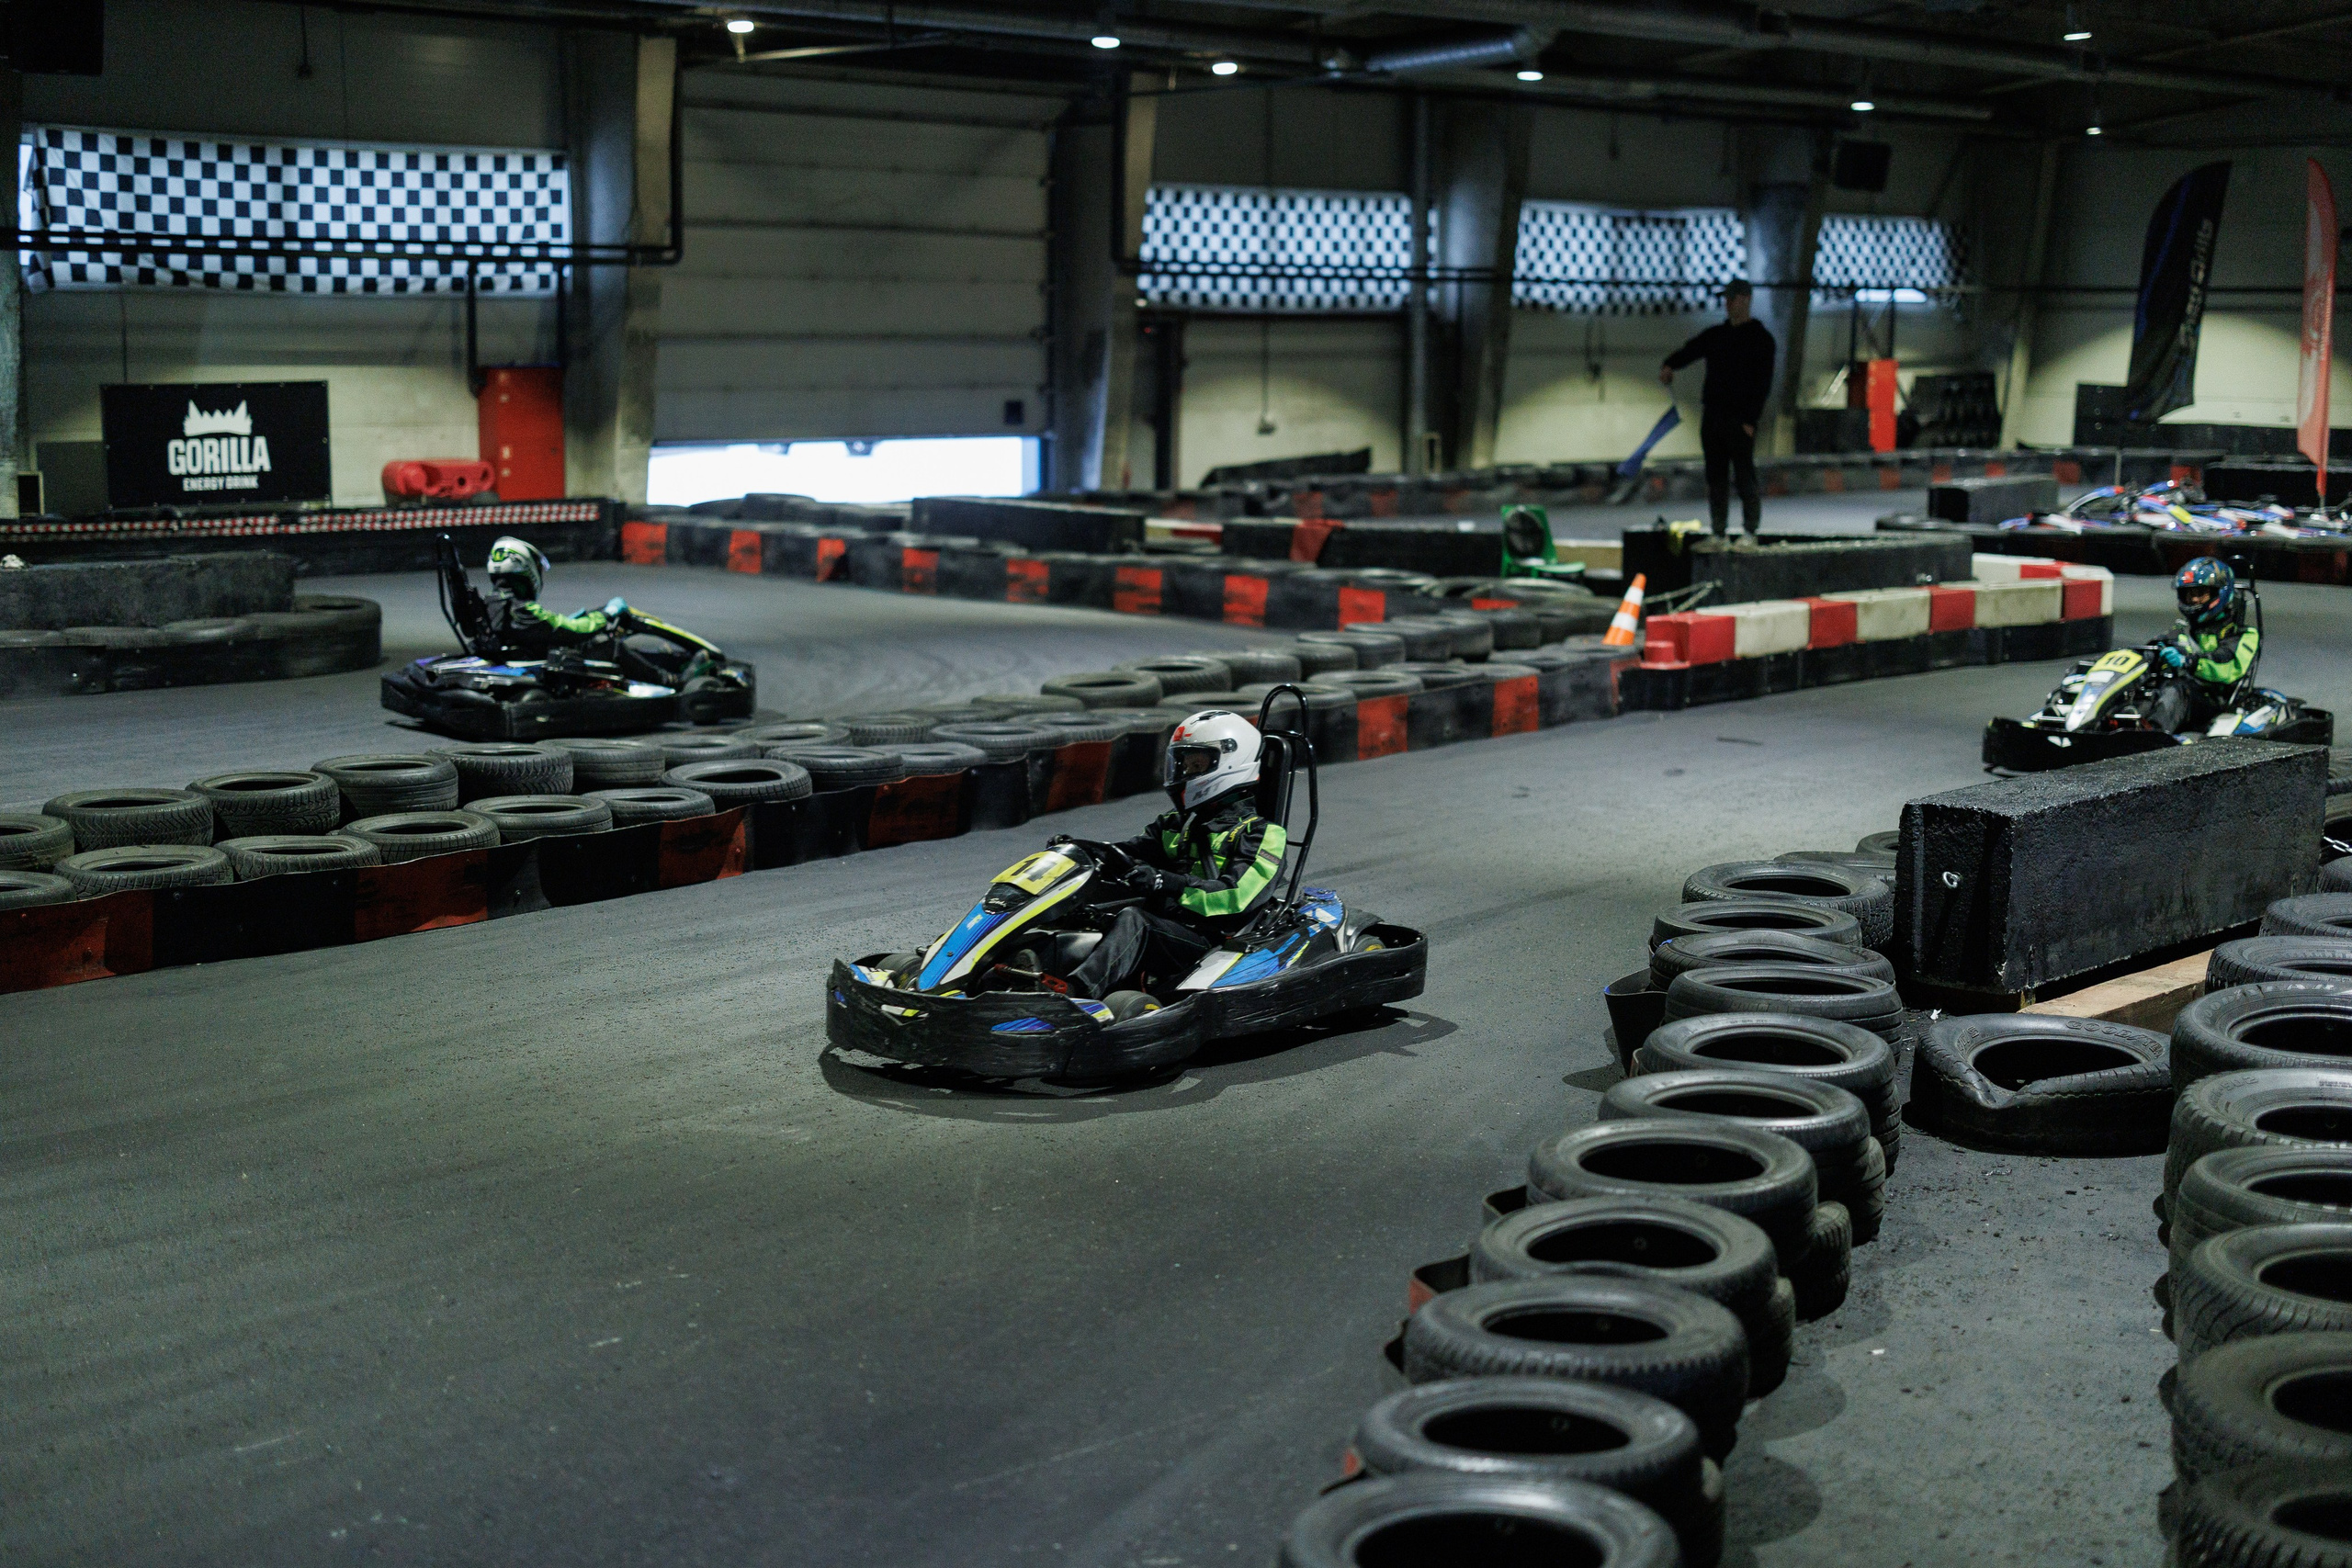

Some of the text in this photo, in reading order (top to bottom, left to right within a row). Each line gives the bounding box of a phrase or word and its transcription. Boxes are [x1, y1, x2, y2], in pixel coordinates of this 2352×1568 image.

[167, 435, 272, 475] GORILLA
[183, 474, 258, 491] ENERGY DRINK
[2105, 655, 2131, 666] 10
